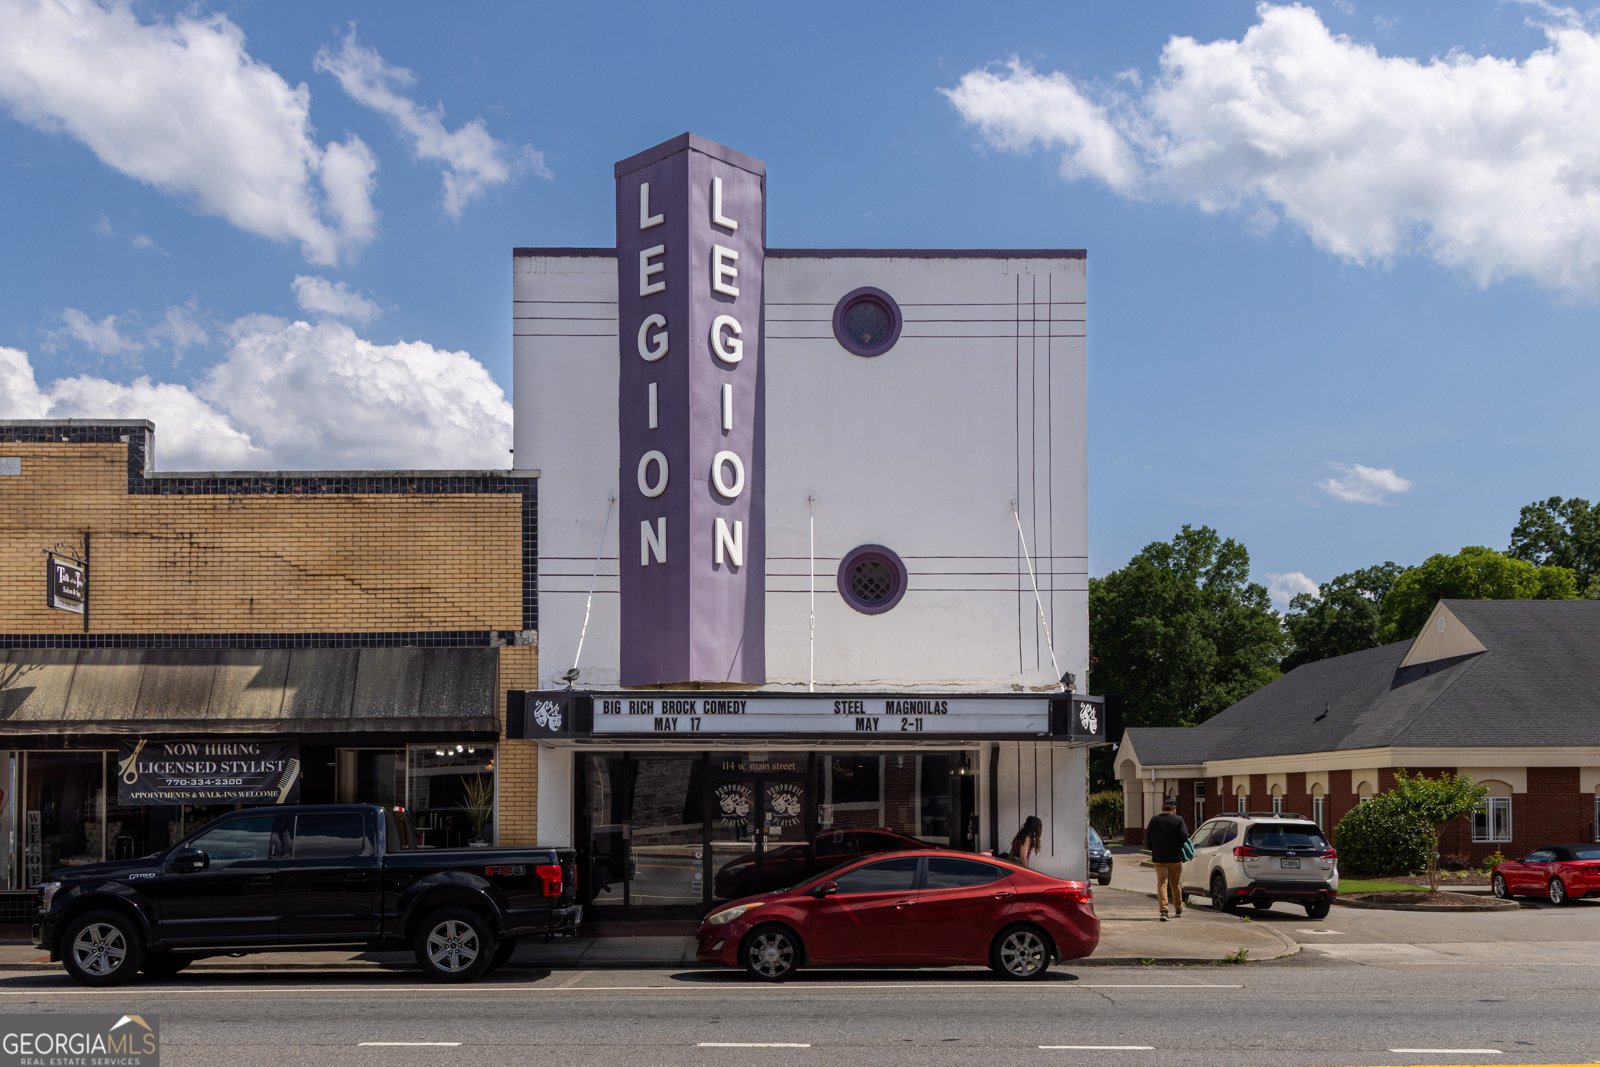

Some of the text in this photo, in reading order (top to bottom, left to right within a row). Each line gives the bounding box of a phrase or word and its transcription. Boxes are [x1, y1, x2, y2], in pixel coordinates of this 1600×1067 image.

[637, 182, 669, 566] LEGION
[712, 176, 745, 567] LEGION
[603, 700, 747, 715] BIG RICH BROCK COMEDY
[834, 700, 948, 715] STEEL MAGNOILAS
[654, 717, 701, 732] MAY 17
[855, 717, 923, 732] MAY 2-11
[163, 743, 260, 756] NOW HIRING
[138, 760, 285, 774] LICENSED STYLIST
[722, 761, 735, 770] 114
[749, 761, 770, 770] main
[772, 761, 796, 770] street
[165, 778, 243, 786] 770-334-2300
[129, 791, 191, 799] APPOINTMENTS
[238, 790, 279, 798] WELCOME
[715, 784, 752, 797] PUMPHOUSE
[767, 784, 805, 797] PUMPHOUSE
[29, 813, 41, 884] WELCOME
